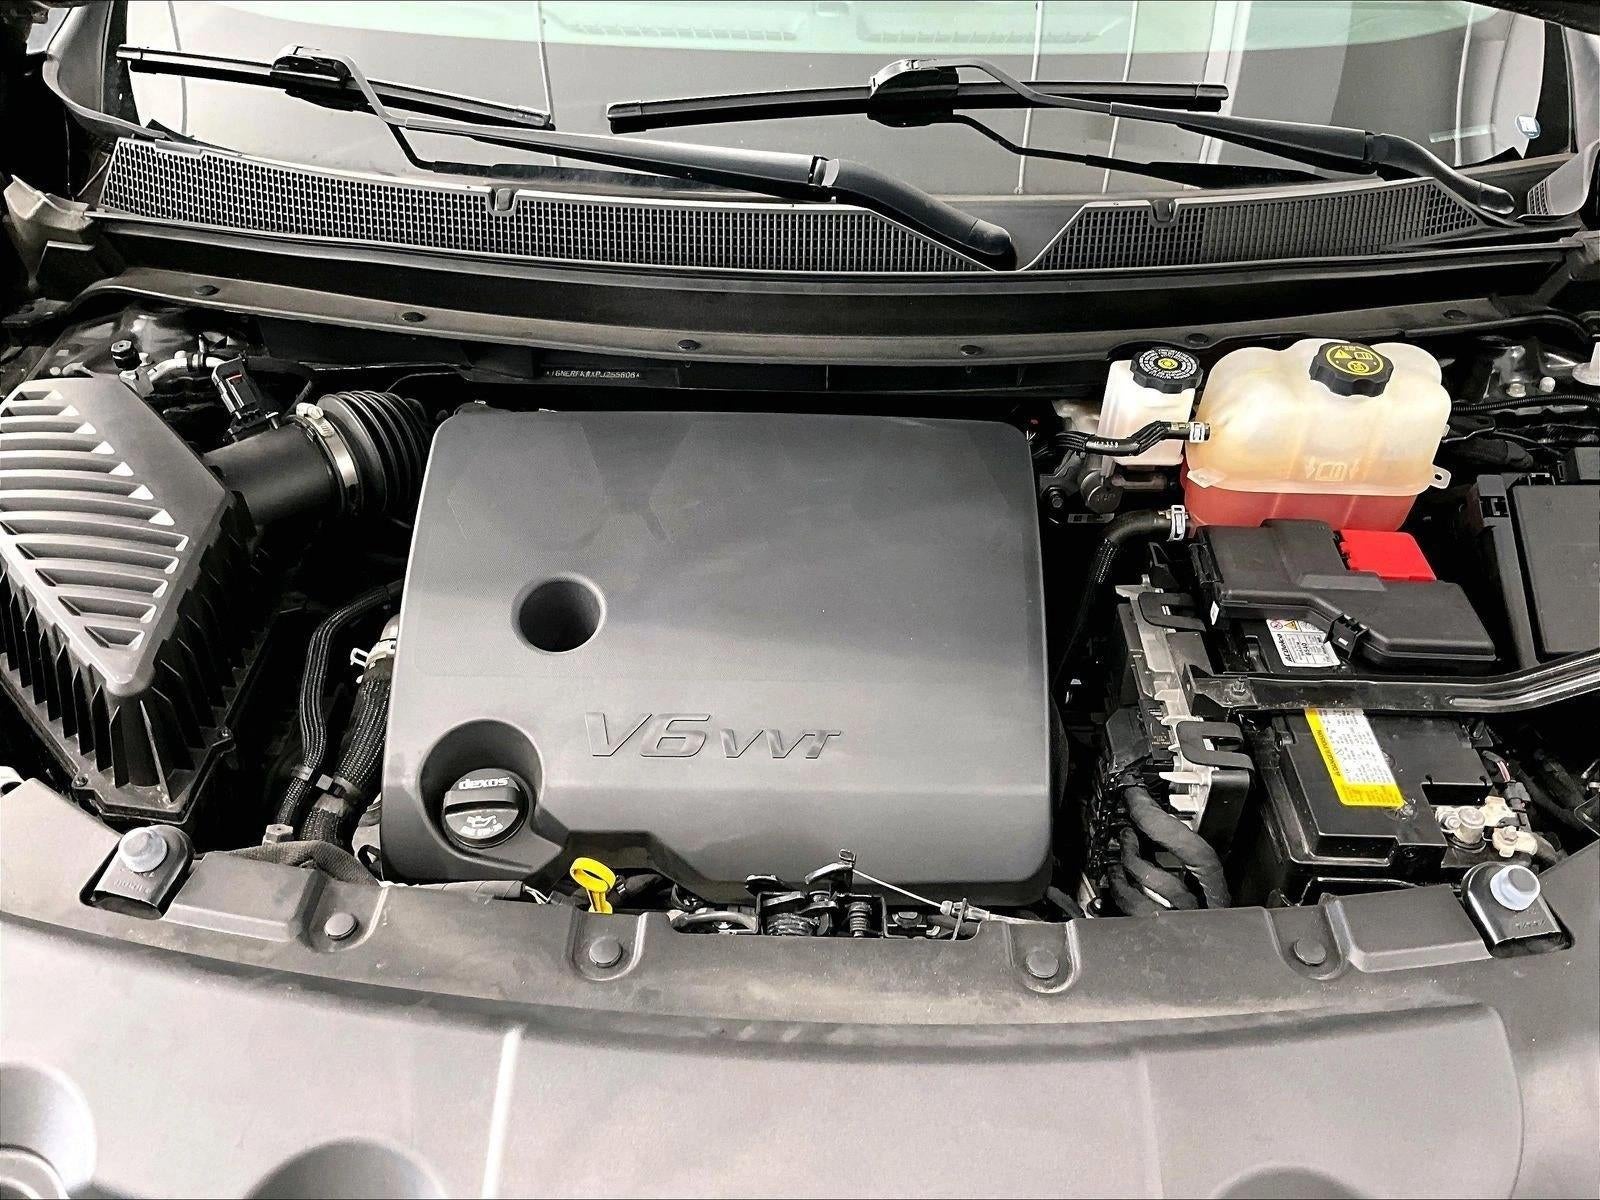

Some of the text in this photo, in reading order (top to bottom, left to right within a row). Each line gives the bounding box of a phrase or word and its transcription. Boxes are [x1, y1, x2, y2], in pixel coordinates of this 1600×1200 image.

[585, 711, 842, 759] V6 VVT
[458, 777, 509, 790] dexos
